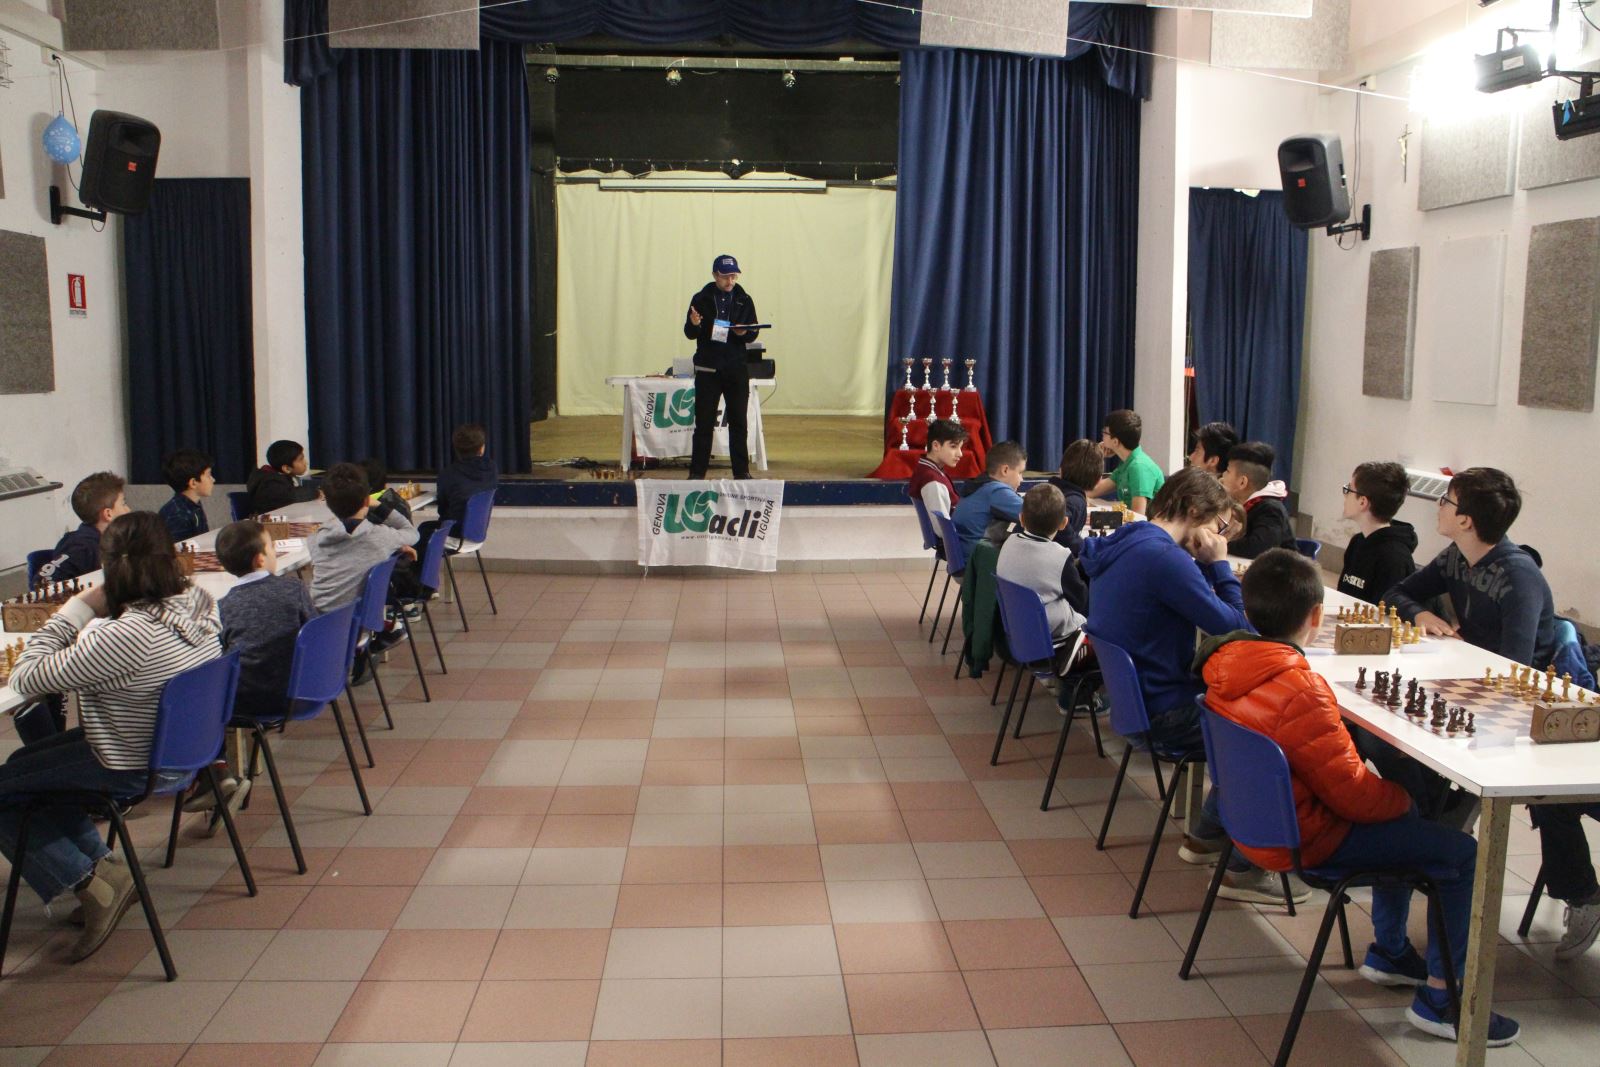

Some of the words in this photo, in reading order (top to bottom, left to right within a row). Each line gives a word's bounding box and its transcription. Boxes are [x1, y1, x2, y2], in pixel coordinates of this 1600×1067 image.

[643, 391, 655, 430] GENOVA
[652, 493, 667, 536] GENOVA
[756, 500, 775, 541] LIGURIA
